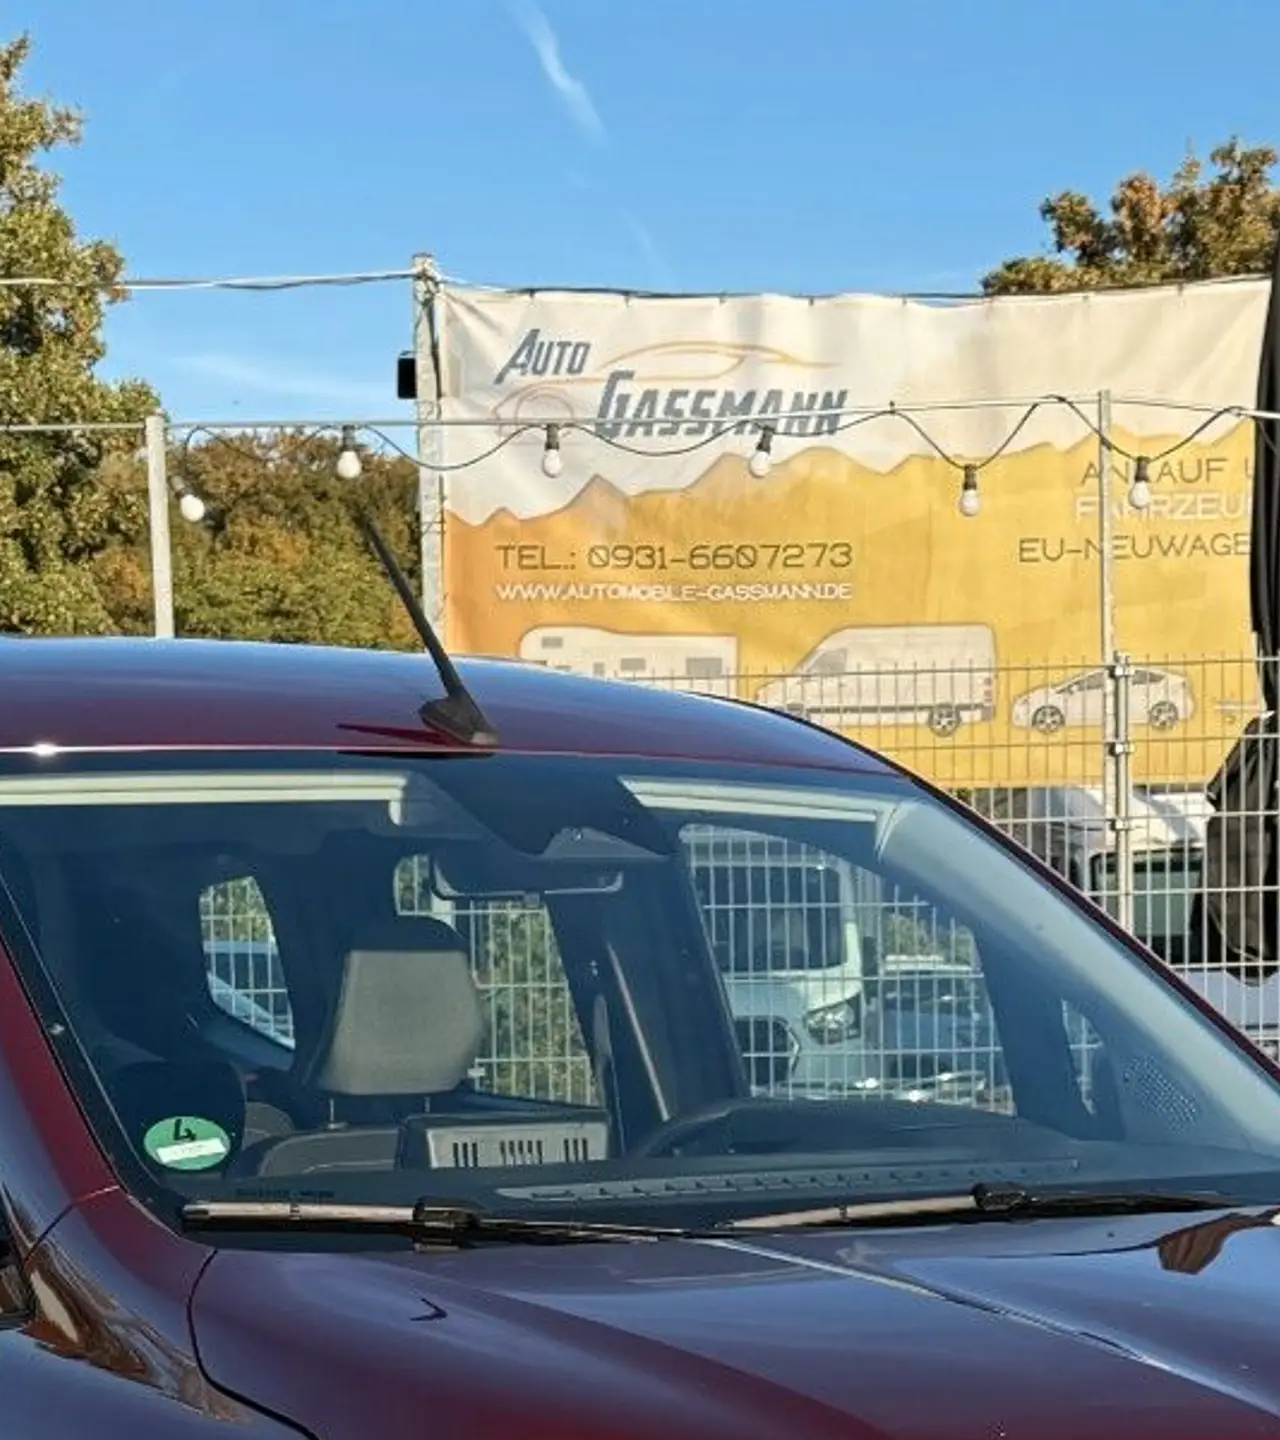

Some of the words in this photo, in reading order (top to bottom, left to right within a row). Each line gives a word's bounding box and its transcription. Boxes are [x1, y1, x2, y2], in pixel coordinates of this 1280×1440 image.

[494, 328, 592, 385] AUTO
[594, 370, 849, 440] GASSMANN
[1080, 457, 1228, 488] ANAUF
[496, 545, 577, 571] TEL.:
[586, 541, 854, 571] 0931-6607273
[1018, 533, 1251, 563] EU-NEUWAGE
